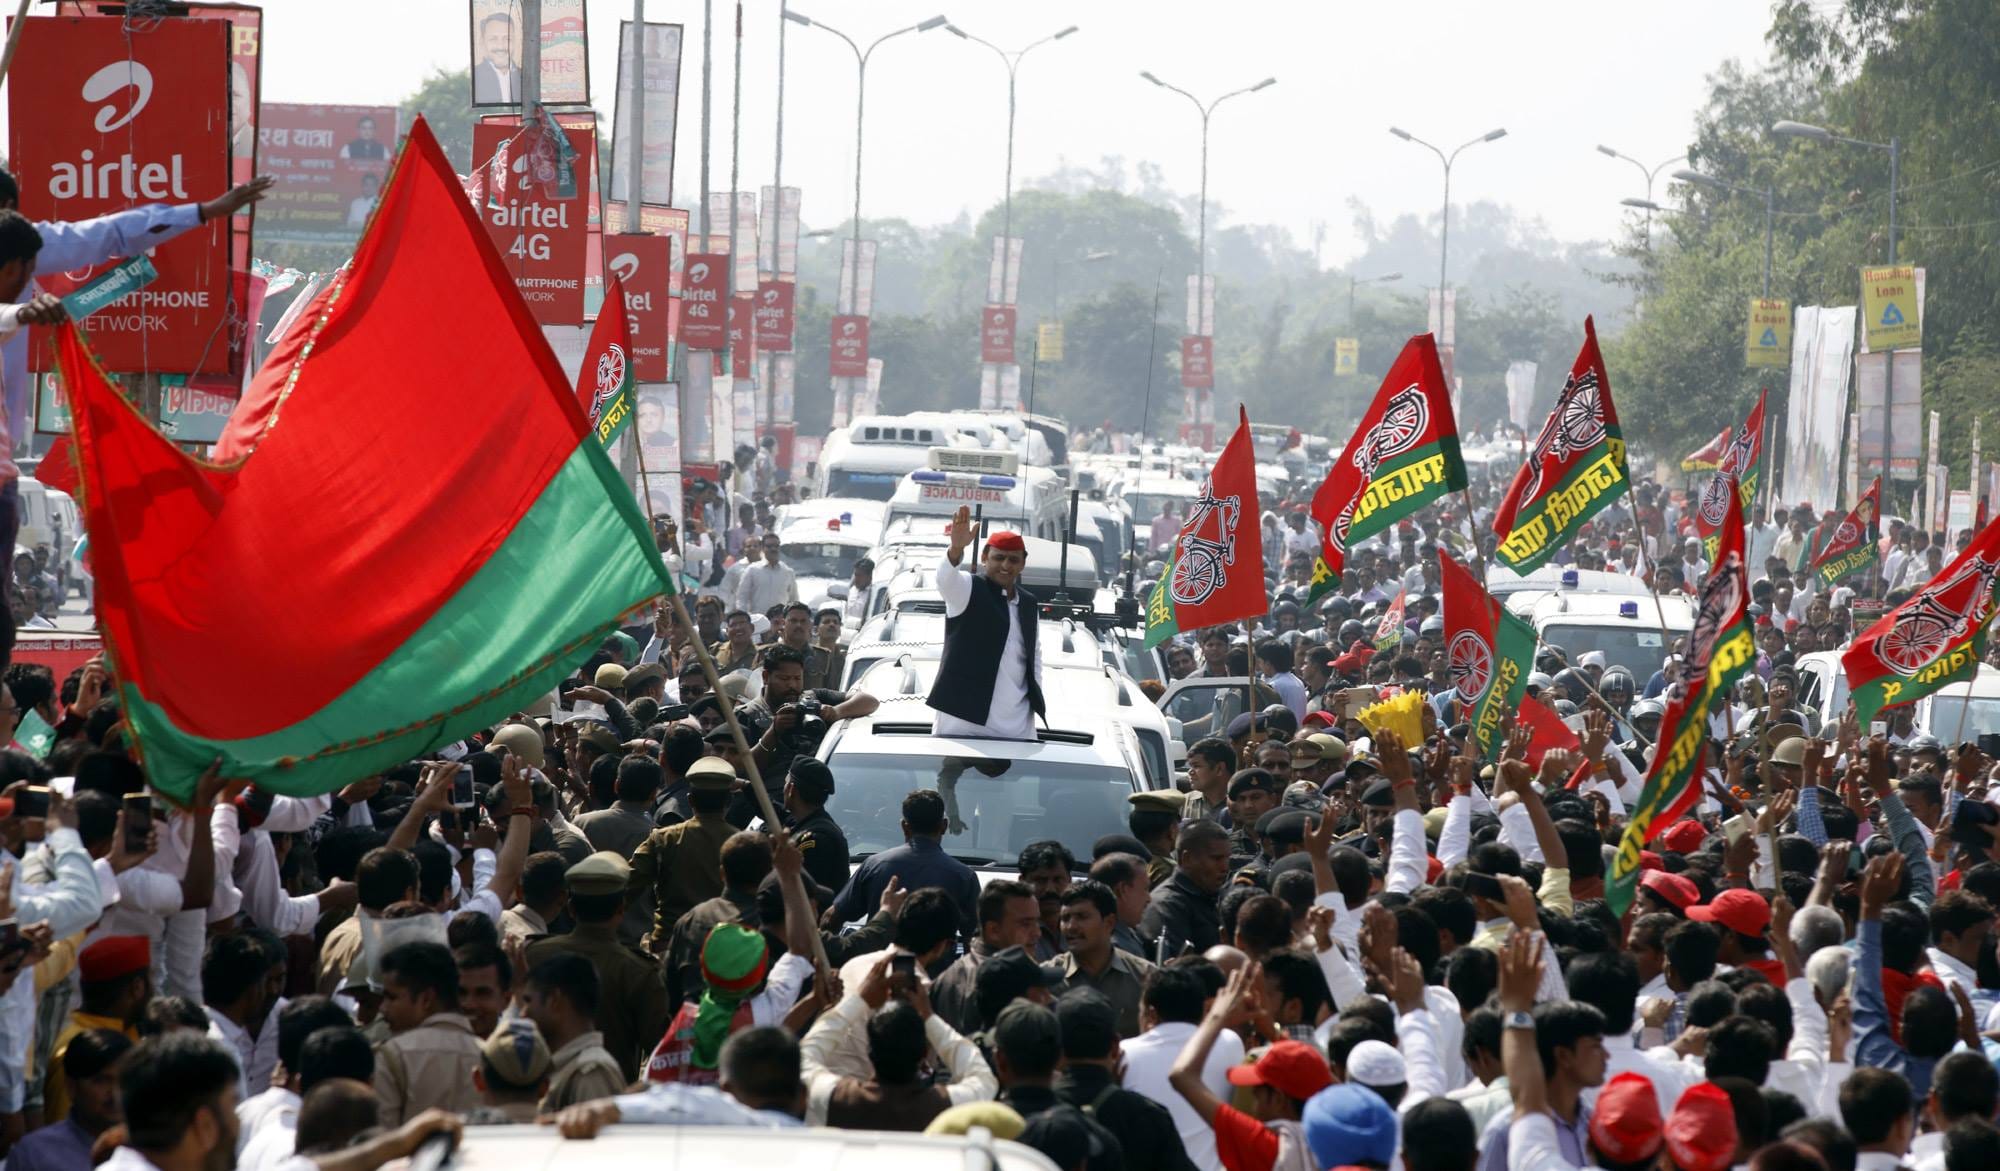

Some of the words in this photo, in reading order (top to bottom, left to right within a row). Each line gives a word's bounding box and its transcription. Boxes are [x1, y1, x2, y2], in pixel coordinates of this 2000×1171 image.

[49, 149, 189, 200] airtel
[492, 199, 569, 229] airtel
[509, 233, 551, 260] 4G
[1865, 267, 1911, 282] Housing
[682, 287, 717, 302] airtel
[1876, 287, 1904, 298] Loan
[688, 303, 709, 317] 4G
